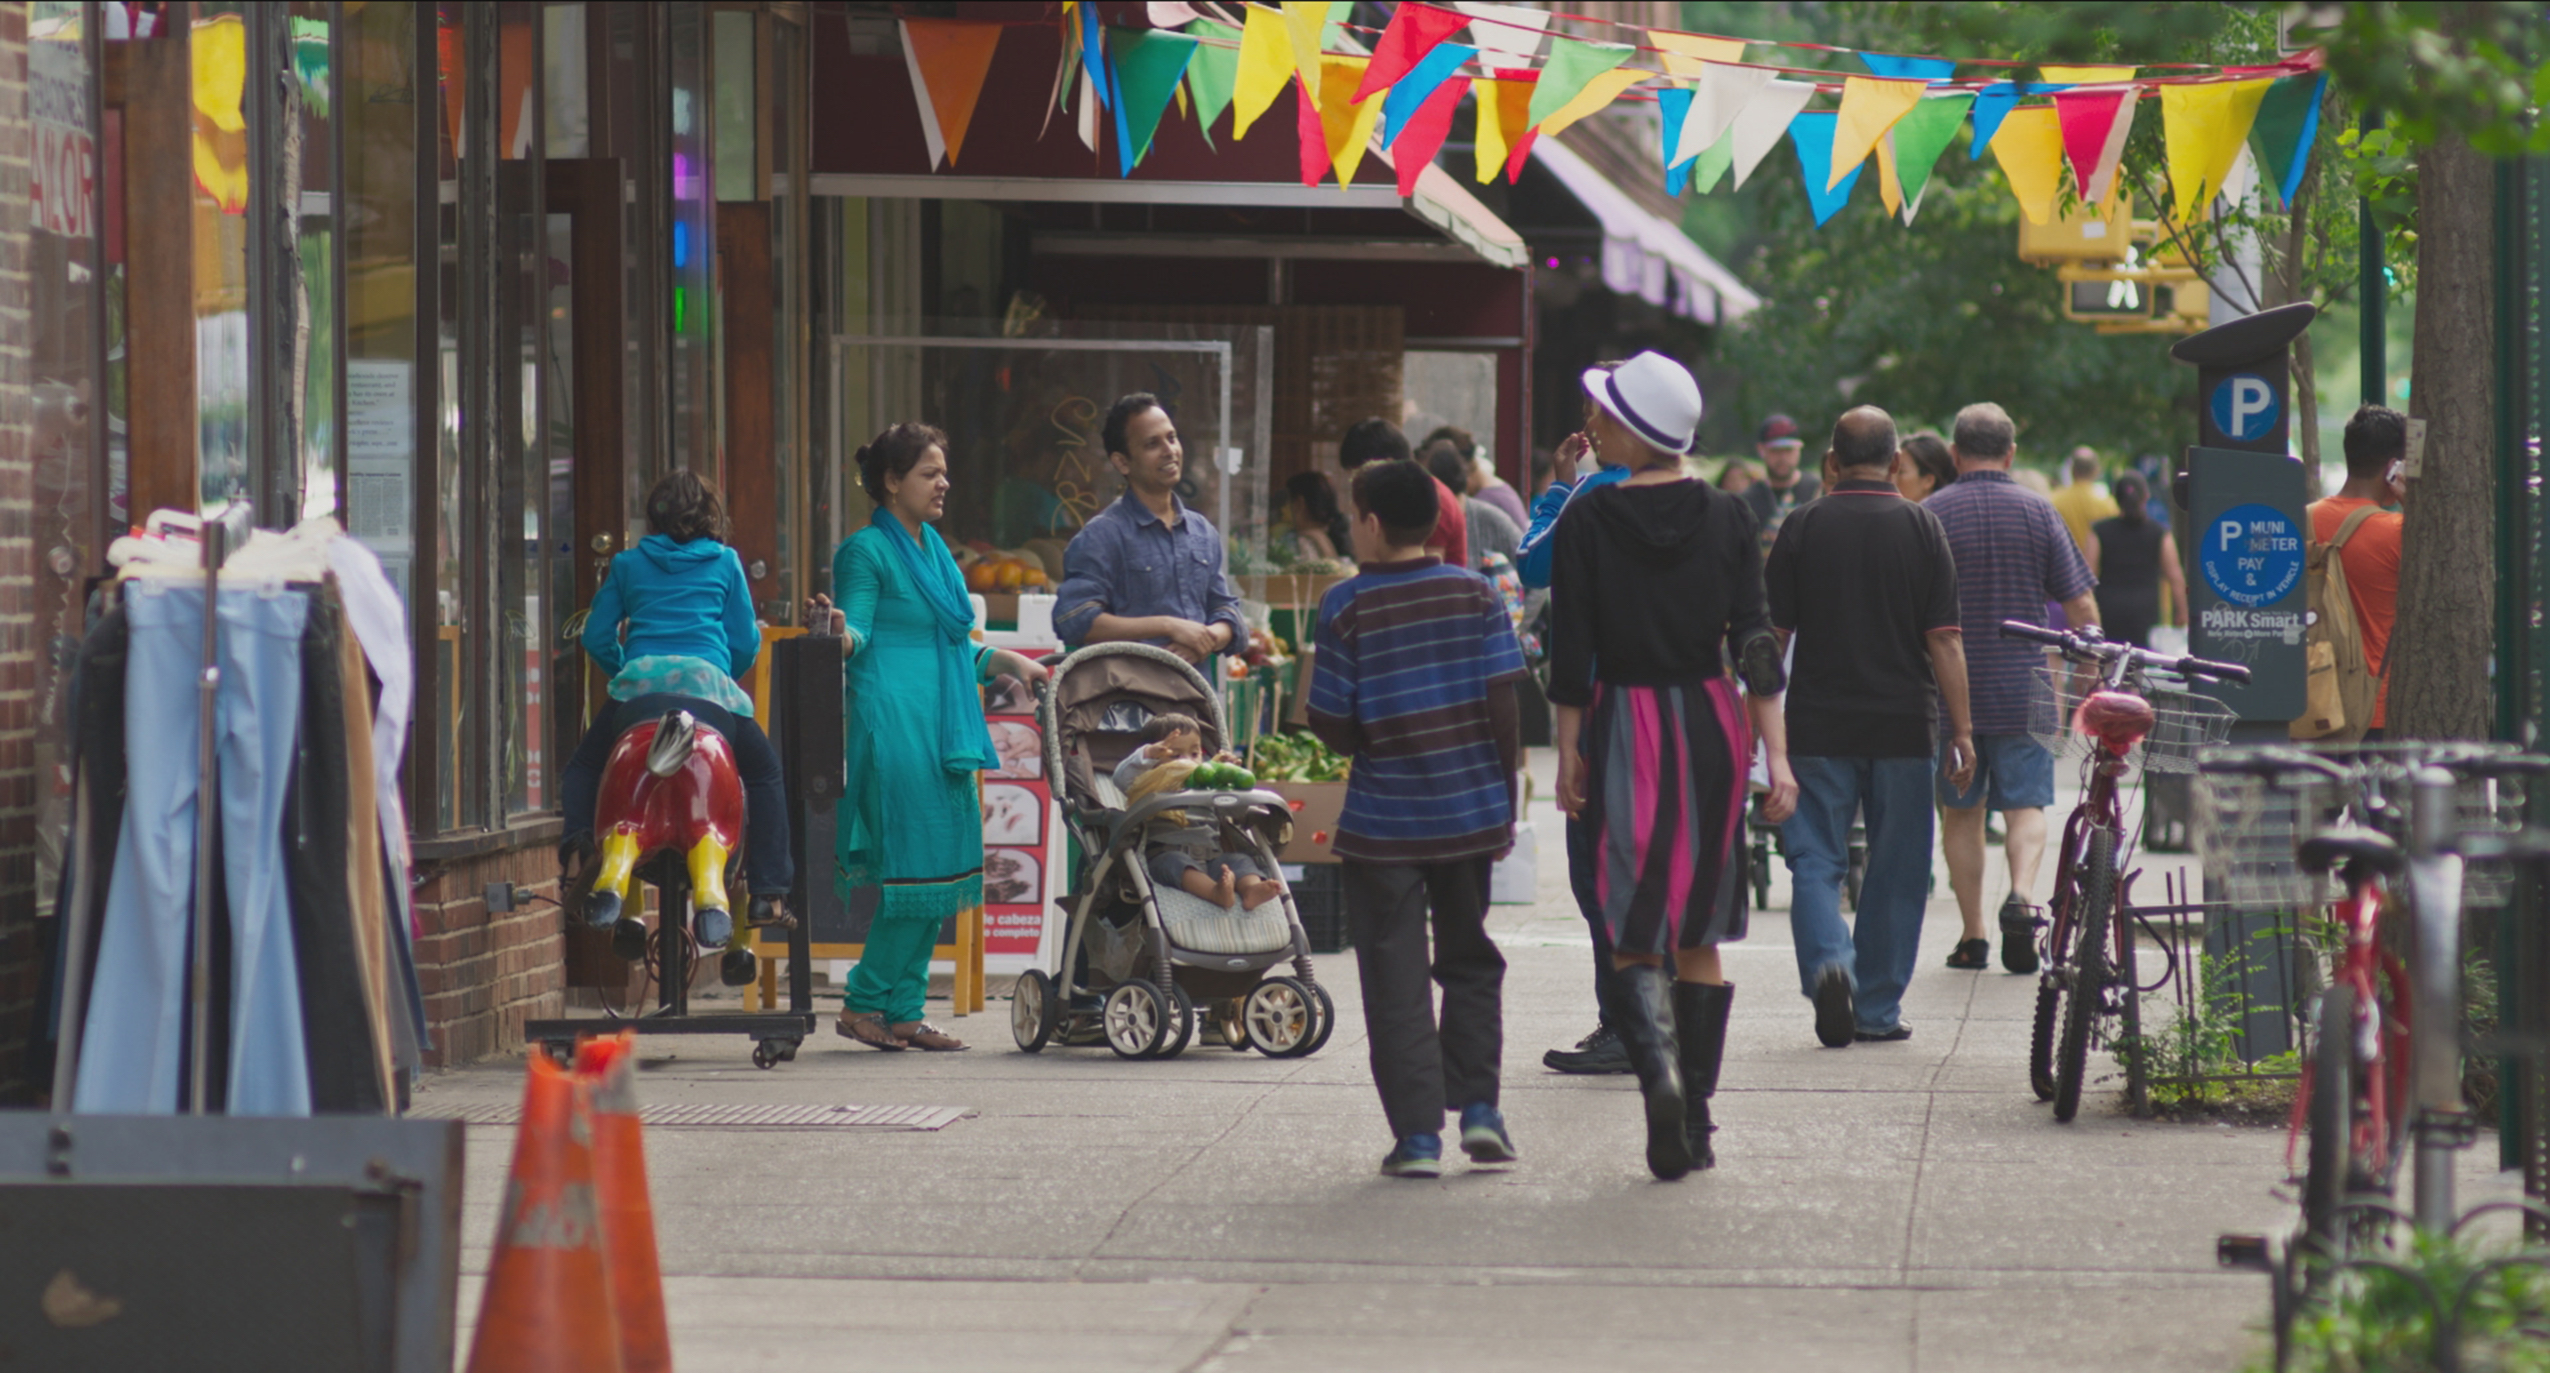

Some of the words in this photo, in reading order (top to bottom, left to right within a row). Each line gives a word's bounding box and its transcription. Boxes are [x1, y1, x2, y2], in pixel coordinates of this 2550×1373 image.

[30, 121, 94, 236] AILOR
[2232, 378, 2271, 436] P
[2250, 521, 2285, 534] MUNI
[2221, 521, 2243, 552] P
[2249, 537, 2298, 551] METER
[2238, 557, 2265, 571] PAY
[2205, 560, 2230, 593] DISPLAY
[2229, 589, 2265, 604] RECEIPT
[2266, 589, 2277, 600] IN
[2275, 560, 2300, 593] VEHICLE
[2245, 572, 2257, 586] &
[2201, 610, 2249, 628] PARK
[2250, 613, 2299, 629] Smart
[997, 912, 1042, 926] cabeza
[992, 928, 1040, 940] completo
